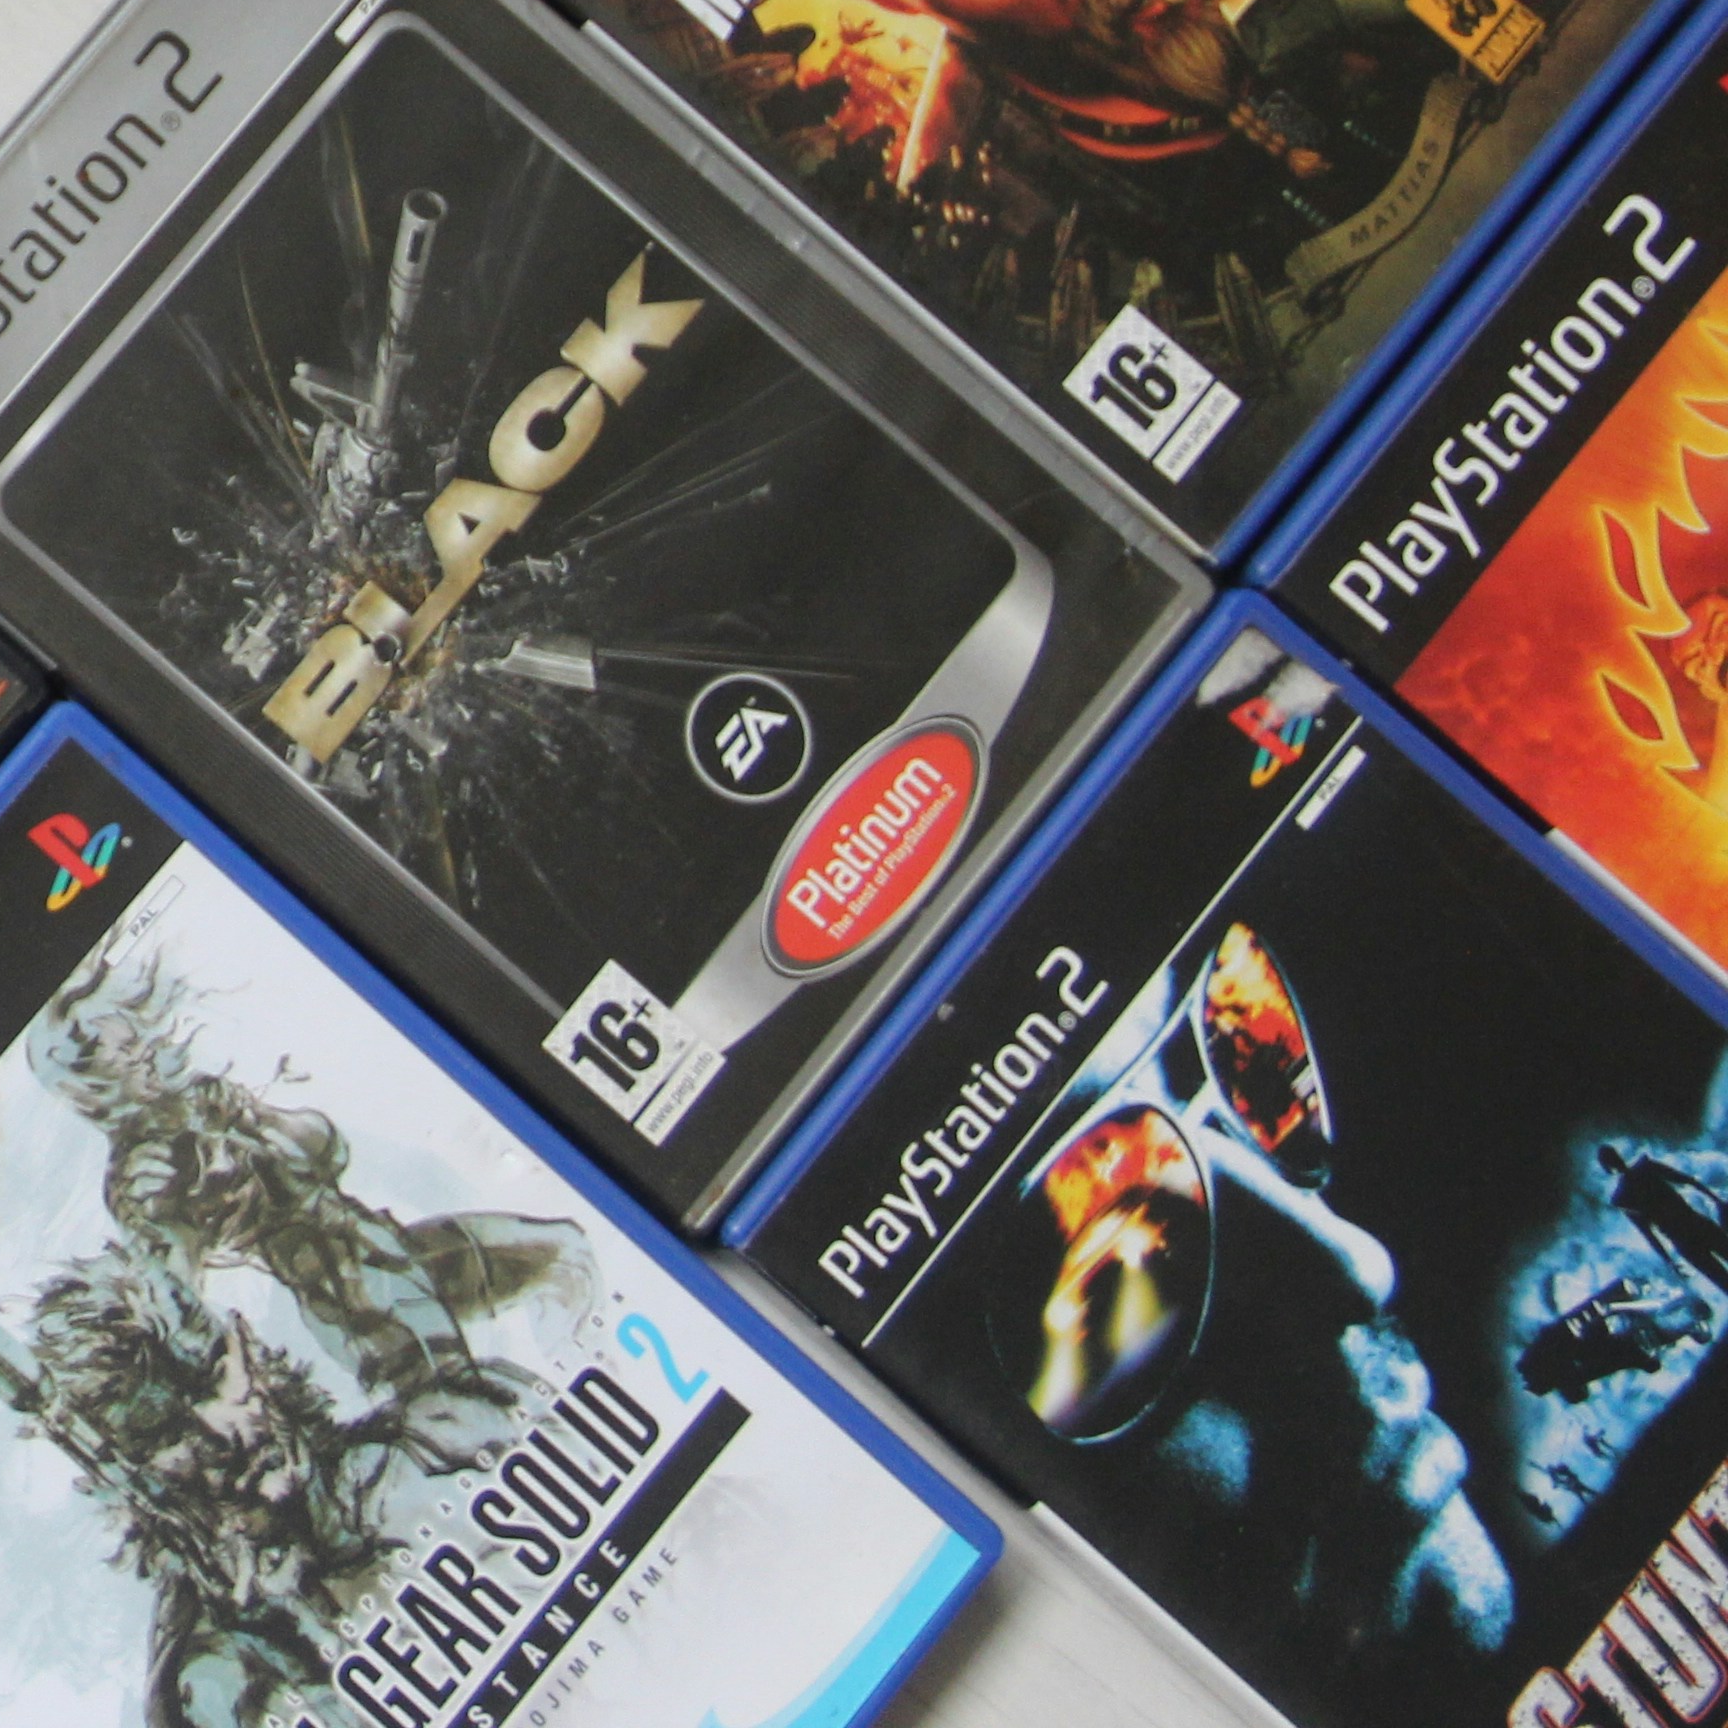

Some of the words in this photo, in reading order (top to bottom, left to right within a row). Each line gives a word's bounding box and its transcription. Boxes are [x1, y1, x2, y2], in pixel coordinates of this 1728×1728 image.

[1349, 138, 1440, 248] MATTIAS
[1089, 338, 1178, 432] 16+
[261, 241, 706, 763] BLACK
[716, 702, 789, 783] EA
[787, 745, 942, 930] Platinum
[826, 910, 855, 942] The
[846, 880, 879, 916] Best
[869, 864, 891, 886] of
[568, 994, 665, 1095] 16+
[334, 1544, 521, 1728] GEAR
[472, 1366, 660, 1577] SOLID
[616, 1312, 710, 1405] 2
[612, 1547, 678, 1627] GAME
